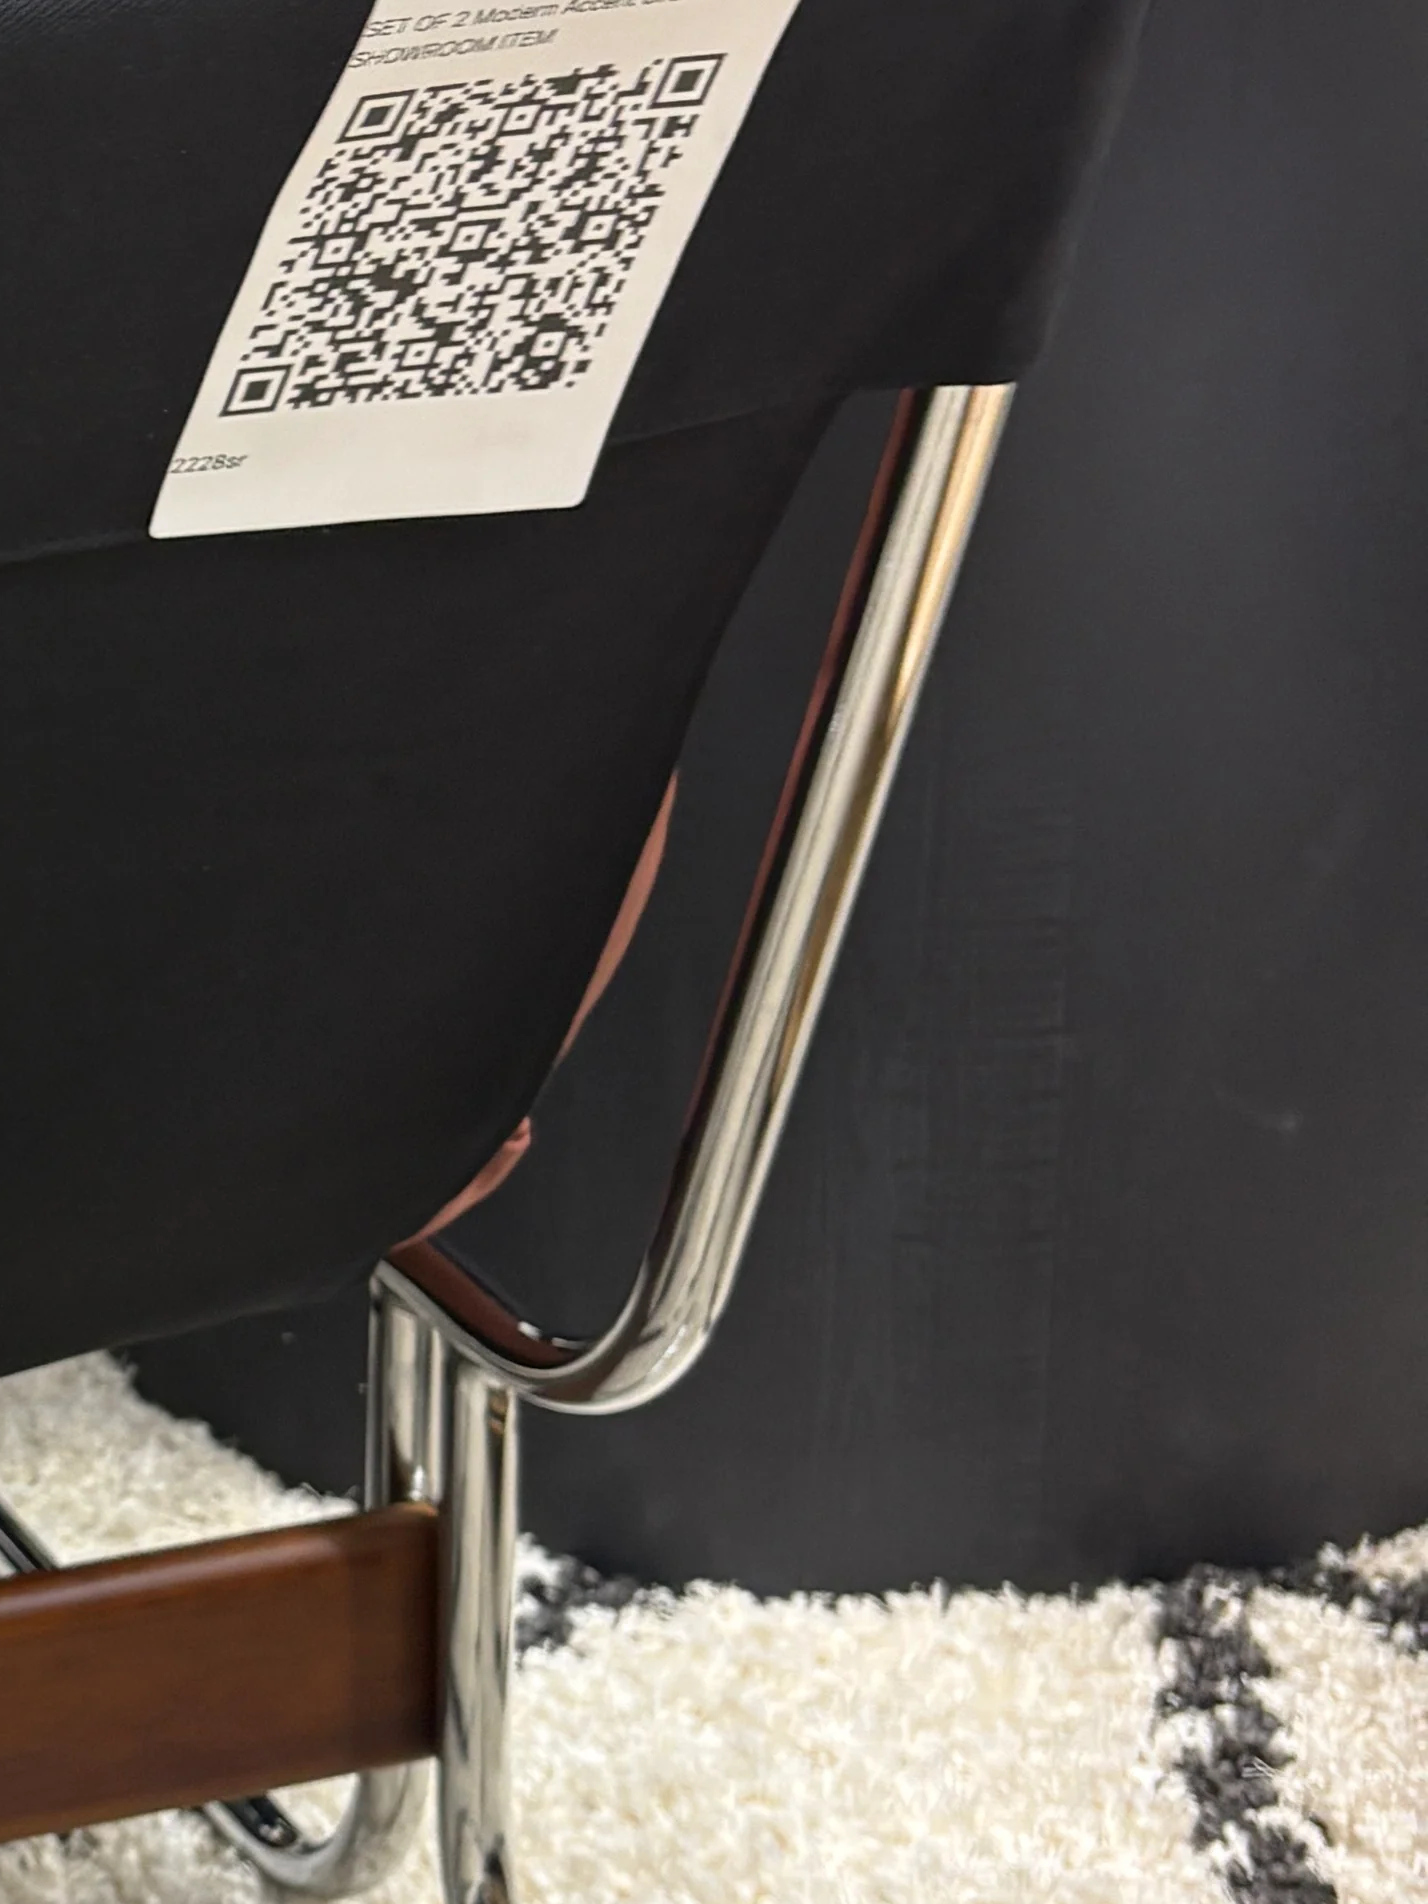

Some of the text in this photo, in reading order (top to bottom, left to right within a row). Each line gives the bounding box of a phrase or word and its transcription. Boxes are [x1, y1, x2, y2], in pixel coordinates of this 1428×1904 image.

[362, 16, 413, 38] SET
[413, 12, 453, 32] OF
[451, 10, 472, 28] 2
[472, 3, 560, 26] Modern
[347, 27, 560, 69] SHOWROOM ITEM
